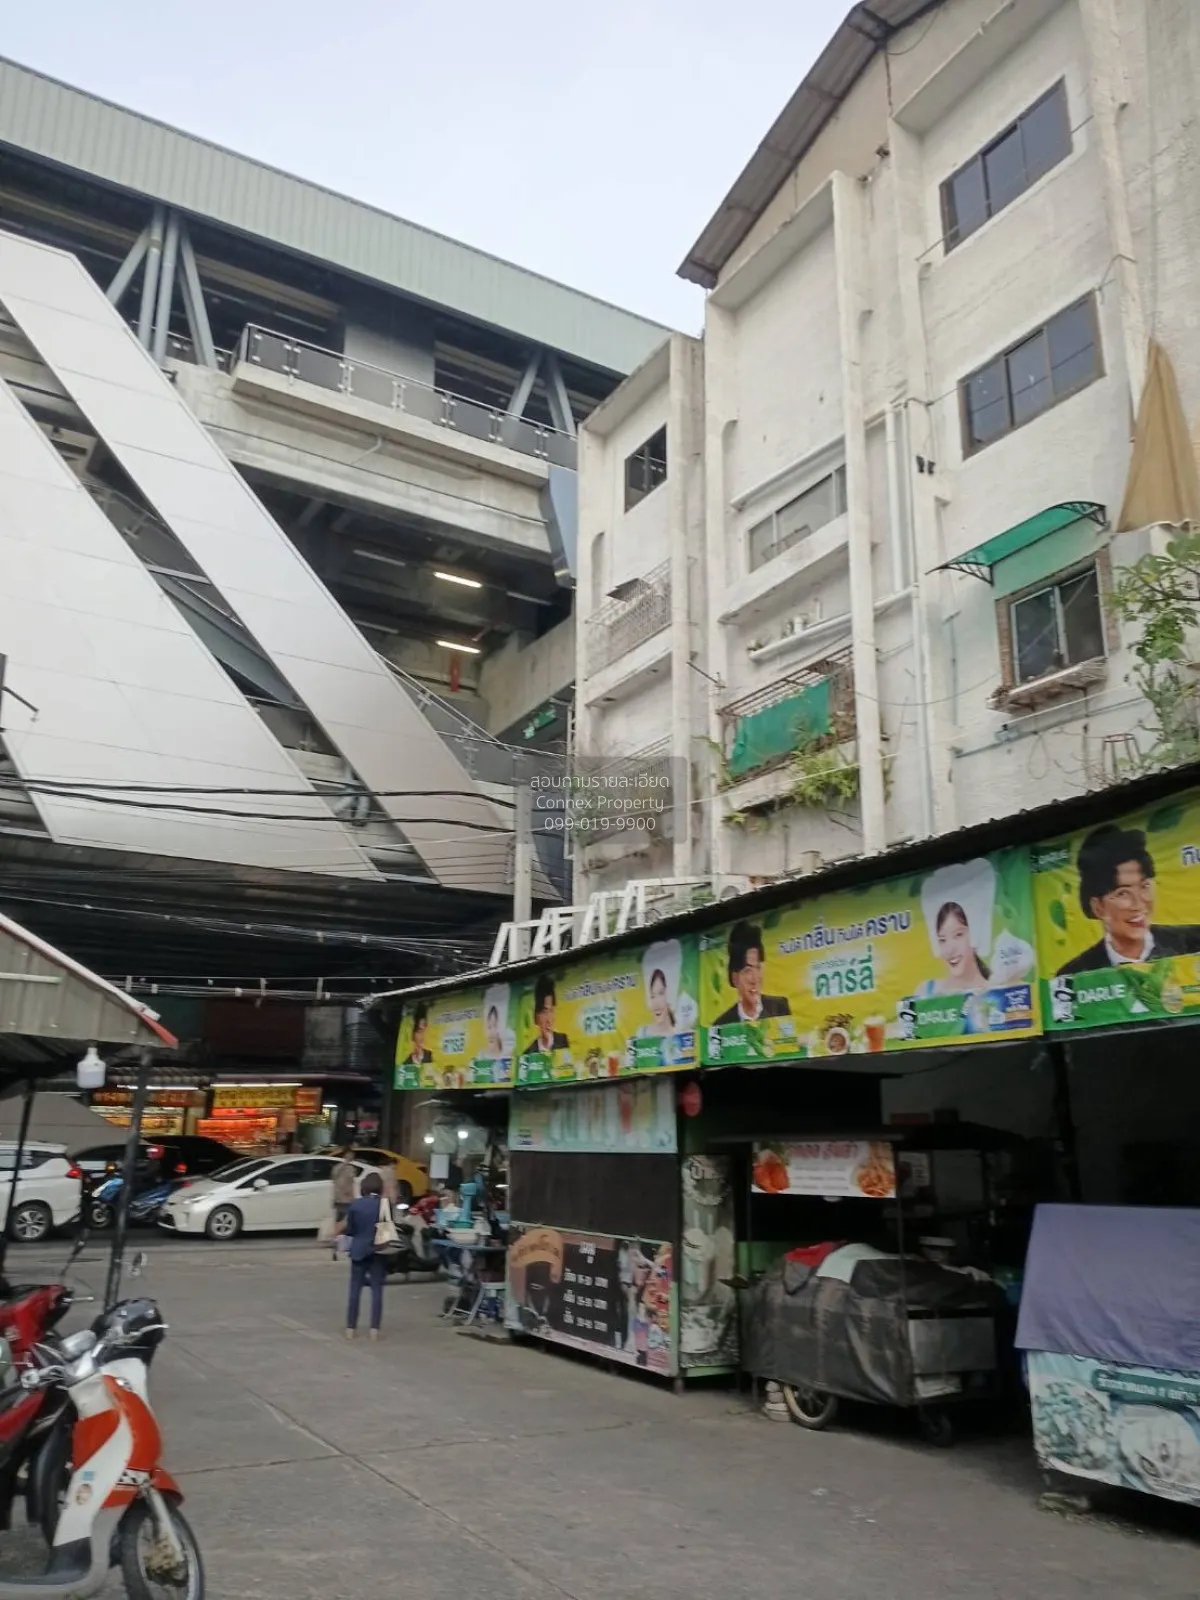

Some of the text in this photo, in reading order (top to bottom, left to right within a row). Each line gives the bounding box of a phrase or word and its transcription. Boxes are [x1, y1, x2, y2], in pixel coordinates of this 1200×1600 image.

[815, 944, 875, 998] ดาร์ลี่
[1077, 984, 1129, 1004] DARLIE
